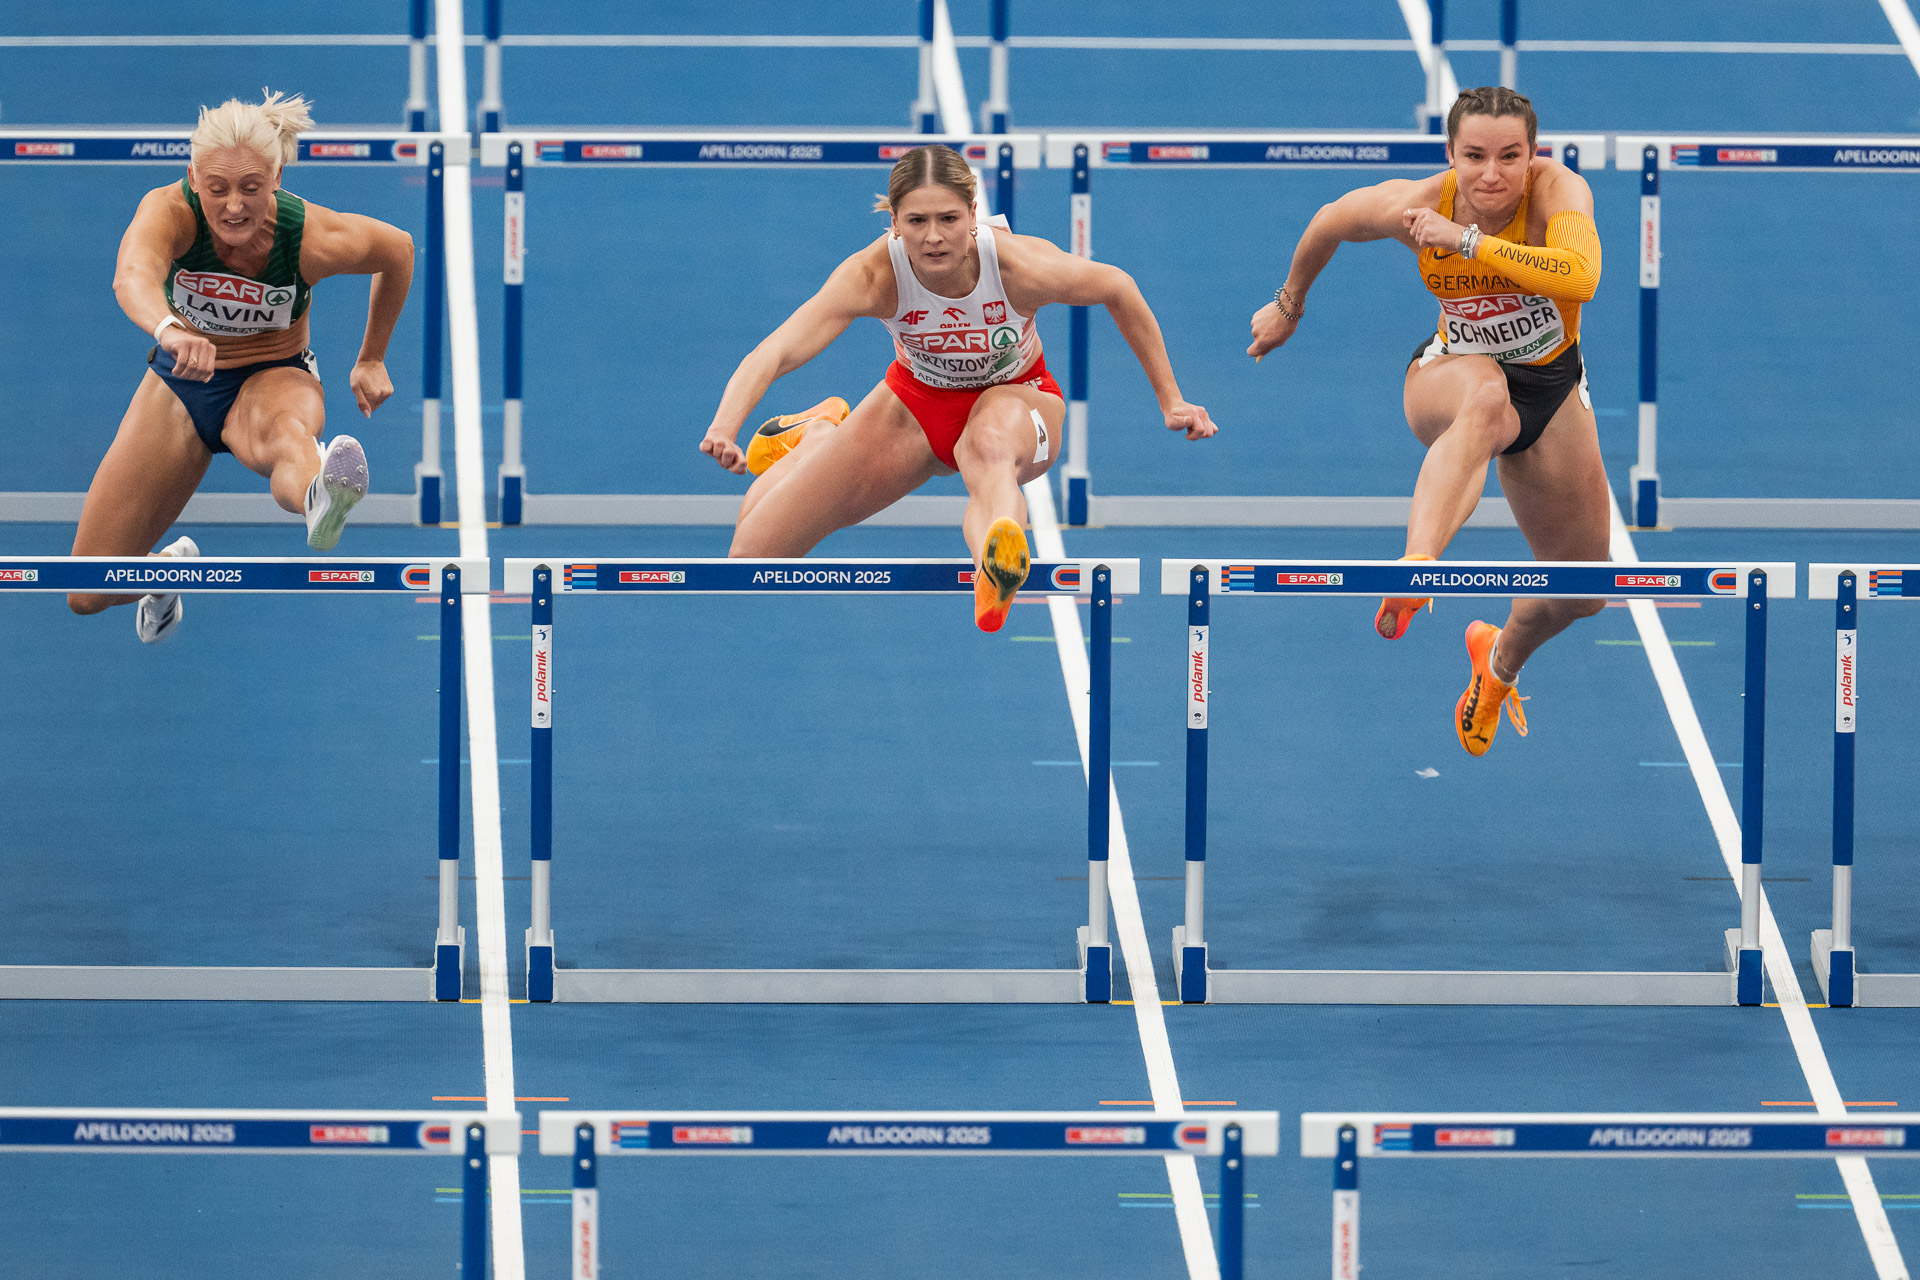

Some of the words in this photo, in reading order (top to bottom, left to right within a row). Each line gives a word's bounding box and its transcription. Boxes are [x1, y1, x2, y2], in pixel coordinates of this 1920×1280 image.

[699, 144, 787, 159] APELDOORN
[788, 144, 823, 160] 2025
[1265, 145, 1354, 160] APELDOORN
[1356, 145, 1390, 161] 2025
[1494, 245, 1571, 275] GERMANY
[178, 276, 260, 302] SPAR
[1427, 273, 1521, 291] GERMAN
[187, 294, 274, 322] LAVIN
[1444, 297, 1518, 317] SPAR
[1449, 306, 1557, 346] SCHNEIDER
[902, 332, 987, 350] SPAR
[1505, 341, 1540, 359] CLEAN
[1038, 423, 1047, 447] 4
[104, 569, 202, 582] APELDOORN
[206, 569, 242, 583] 2025
[320, 572, 359, 581] SPAR
[631, 572, 669, 581] SPAR
[752, 570, 850, 584] APELDOORN
[854, 570, 891, 584] 2025
[1289, 575, 1327, 583] SPAR
[1410, 573, 1508, 587] APELDOORN
[1512, 573, 1549, 587] 2025
[1627, 577, 1665, 585] SPAR
[535, 649, 549, 702] polanik
[1191, 650, 1205, 703] polanik
[1840, 654, 1854, 707] polanik
[74, 1122, 190, 1142] APELDOORN
[191, 1123, 236, 1143] 2025
[827, 1125, 945, 1145] APELDOORN
[946, 1126, 992, 1145] 2025
[1589, 1127, 1706, 1147] APELDOORN
[1707, 1127, 1752, 1147] 2025
